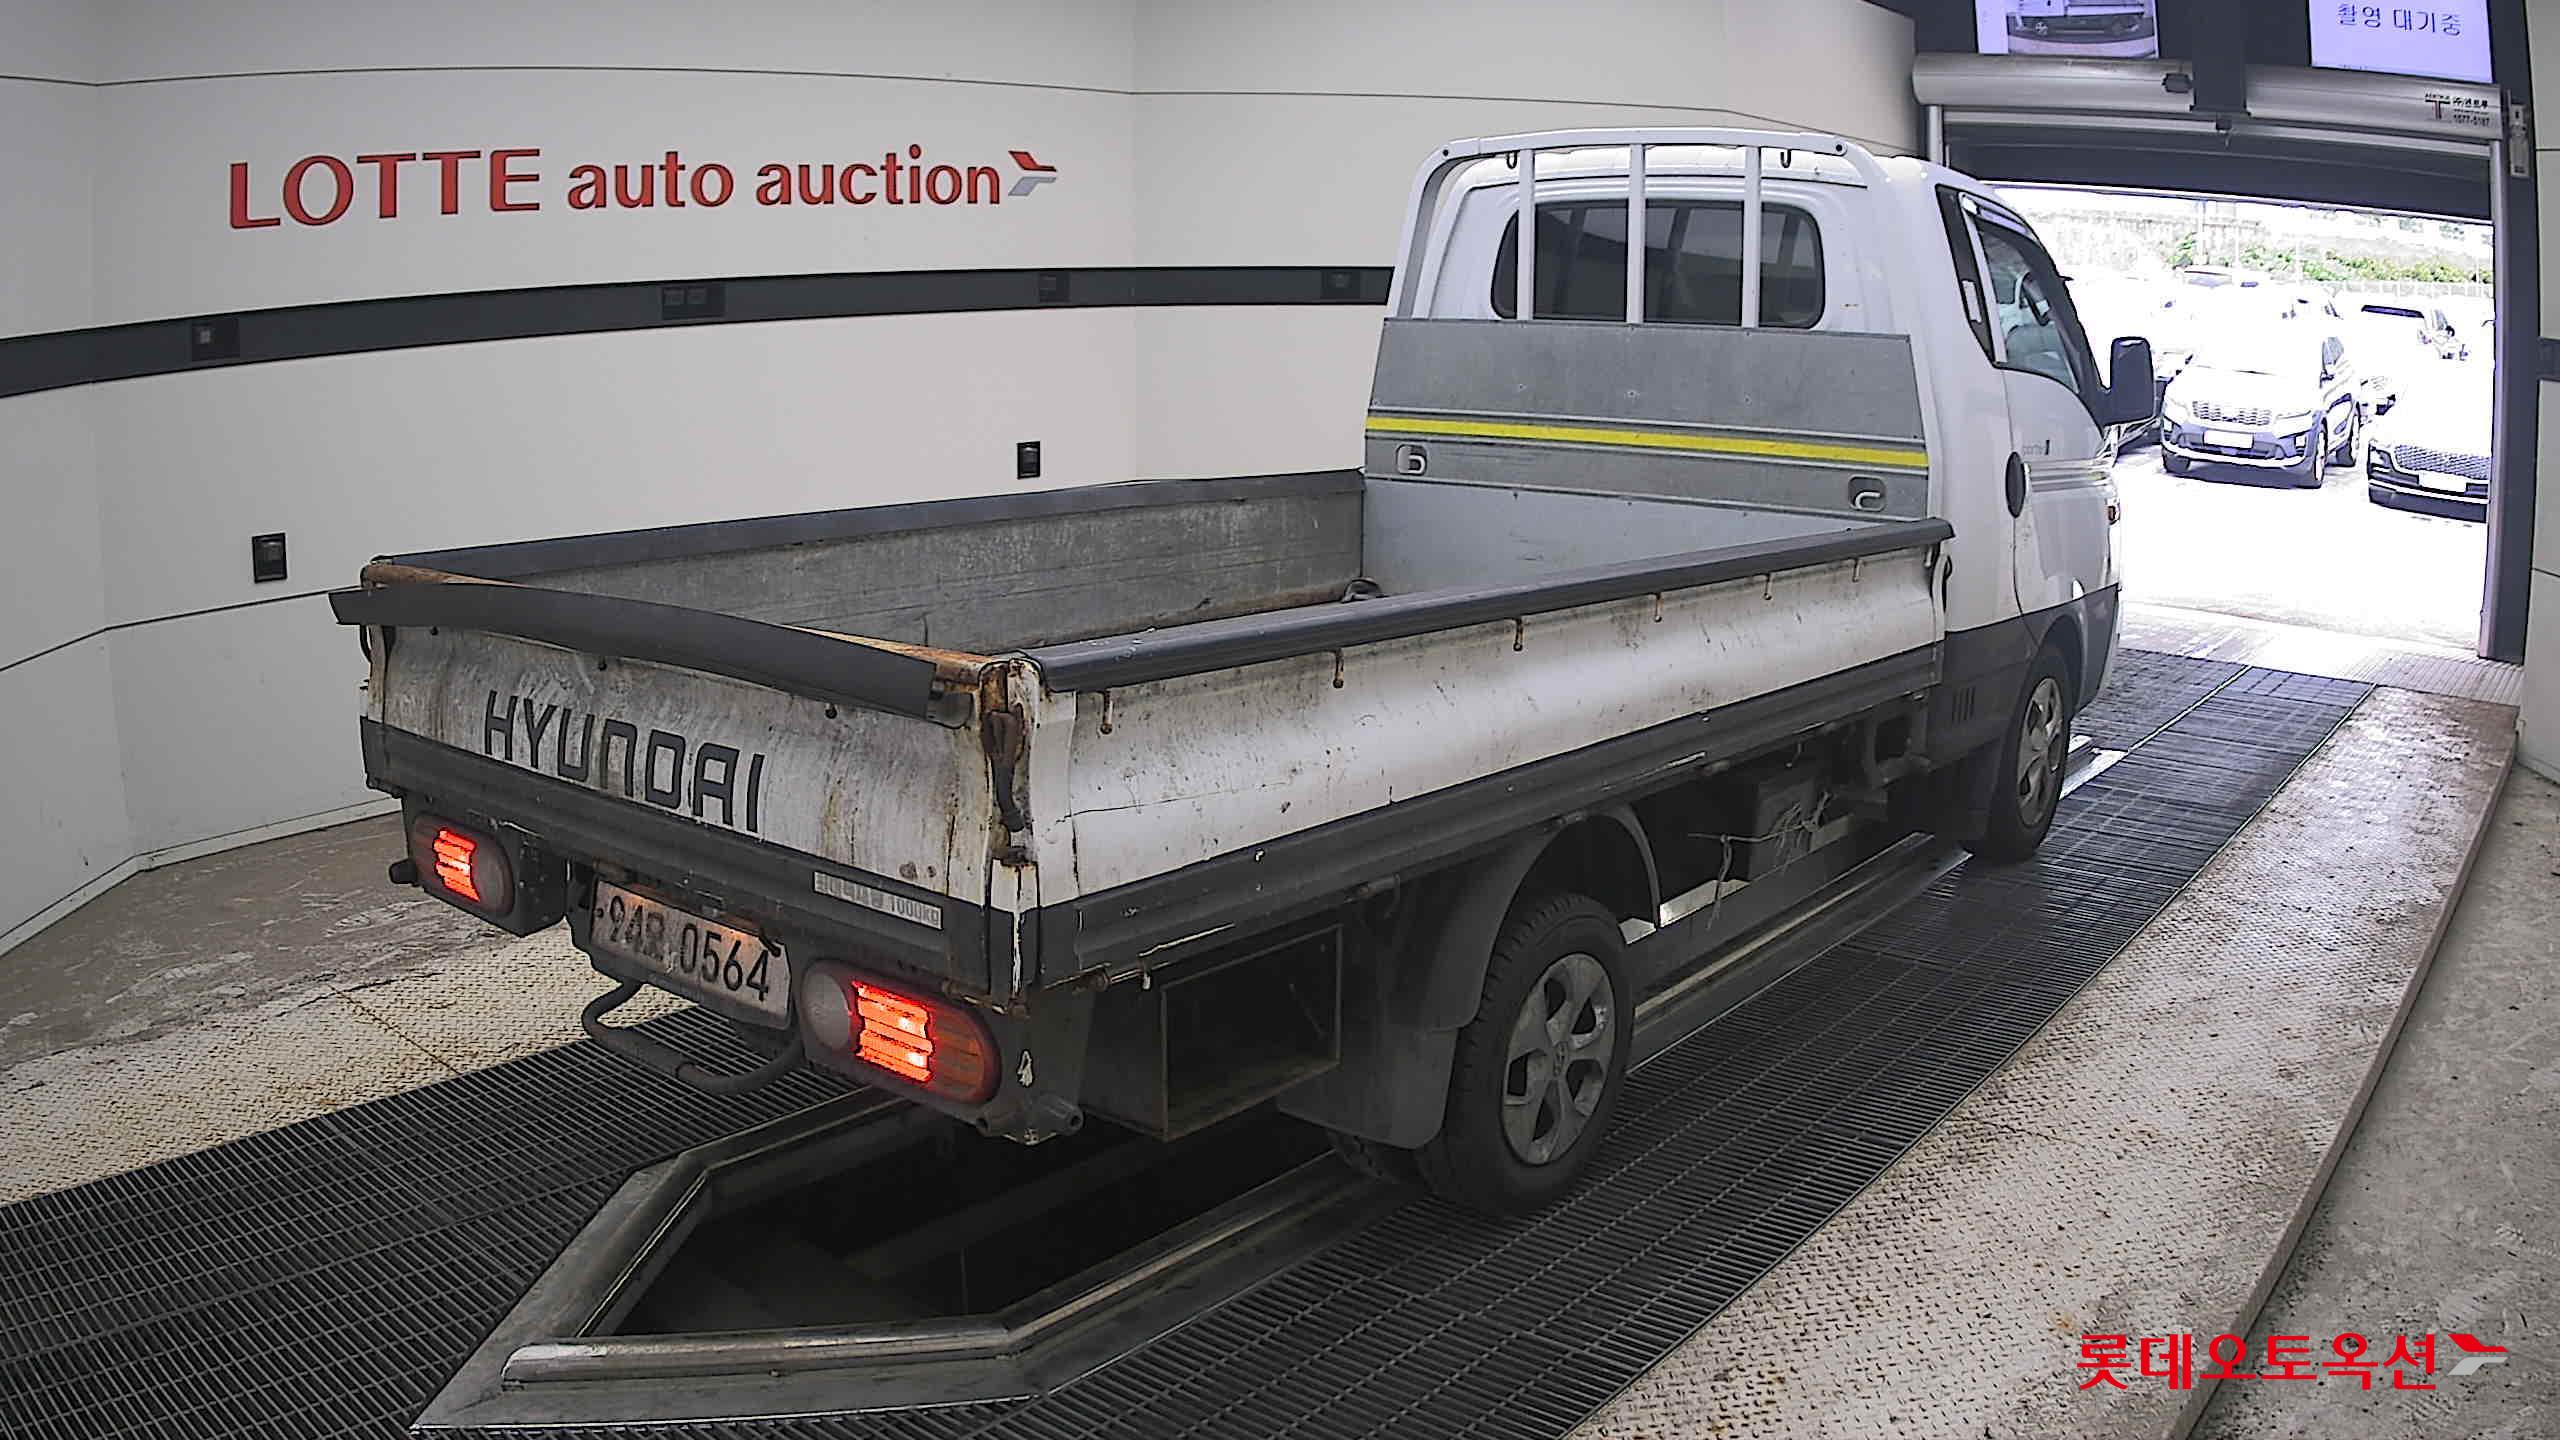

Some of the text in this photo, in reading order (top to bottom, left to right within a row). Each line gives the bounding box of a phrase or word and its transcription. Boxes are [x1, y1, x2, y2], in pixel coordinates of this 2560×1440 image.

[2393, 9, 2462, 36] 대기중
[229, 143, 1002, 229] LOTTE auto auction
[483, 689, 766, 833] HYUNDAI
[679, 922, 770, 1002] 0564
